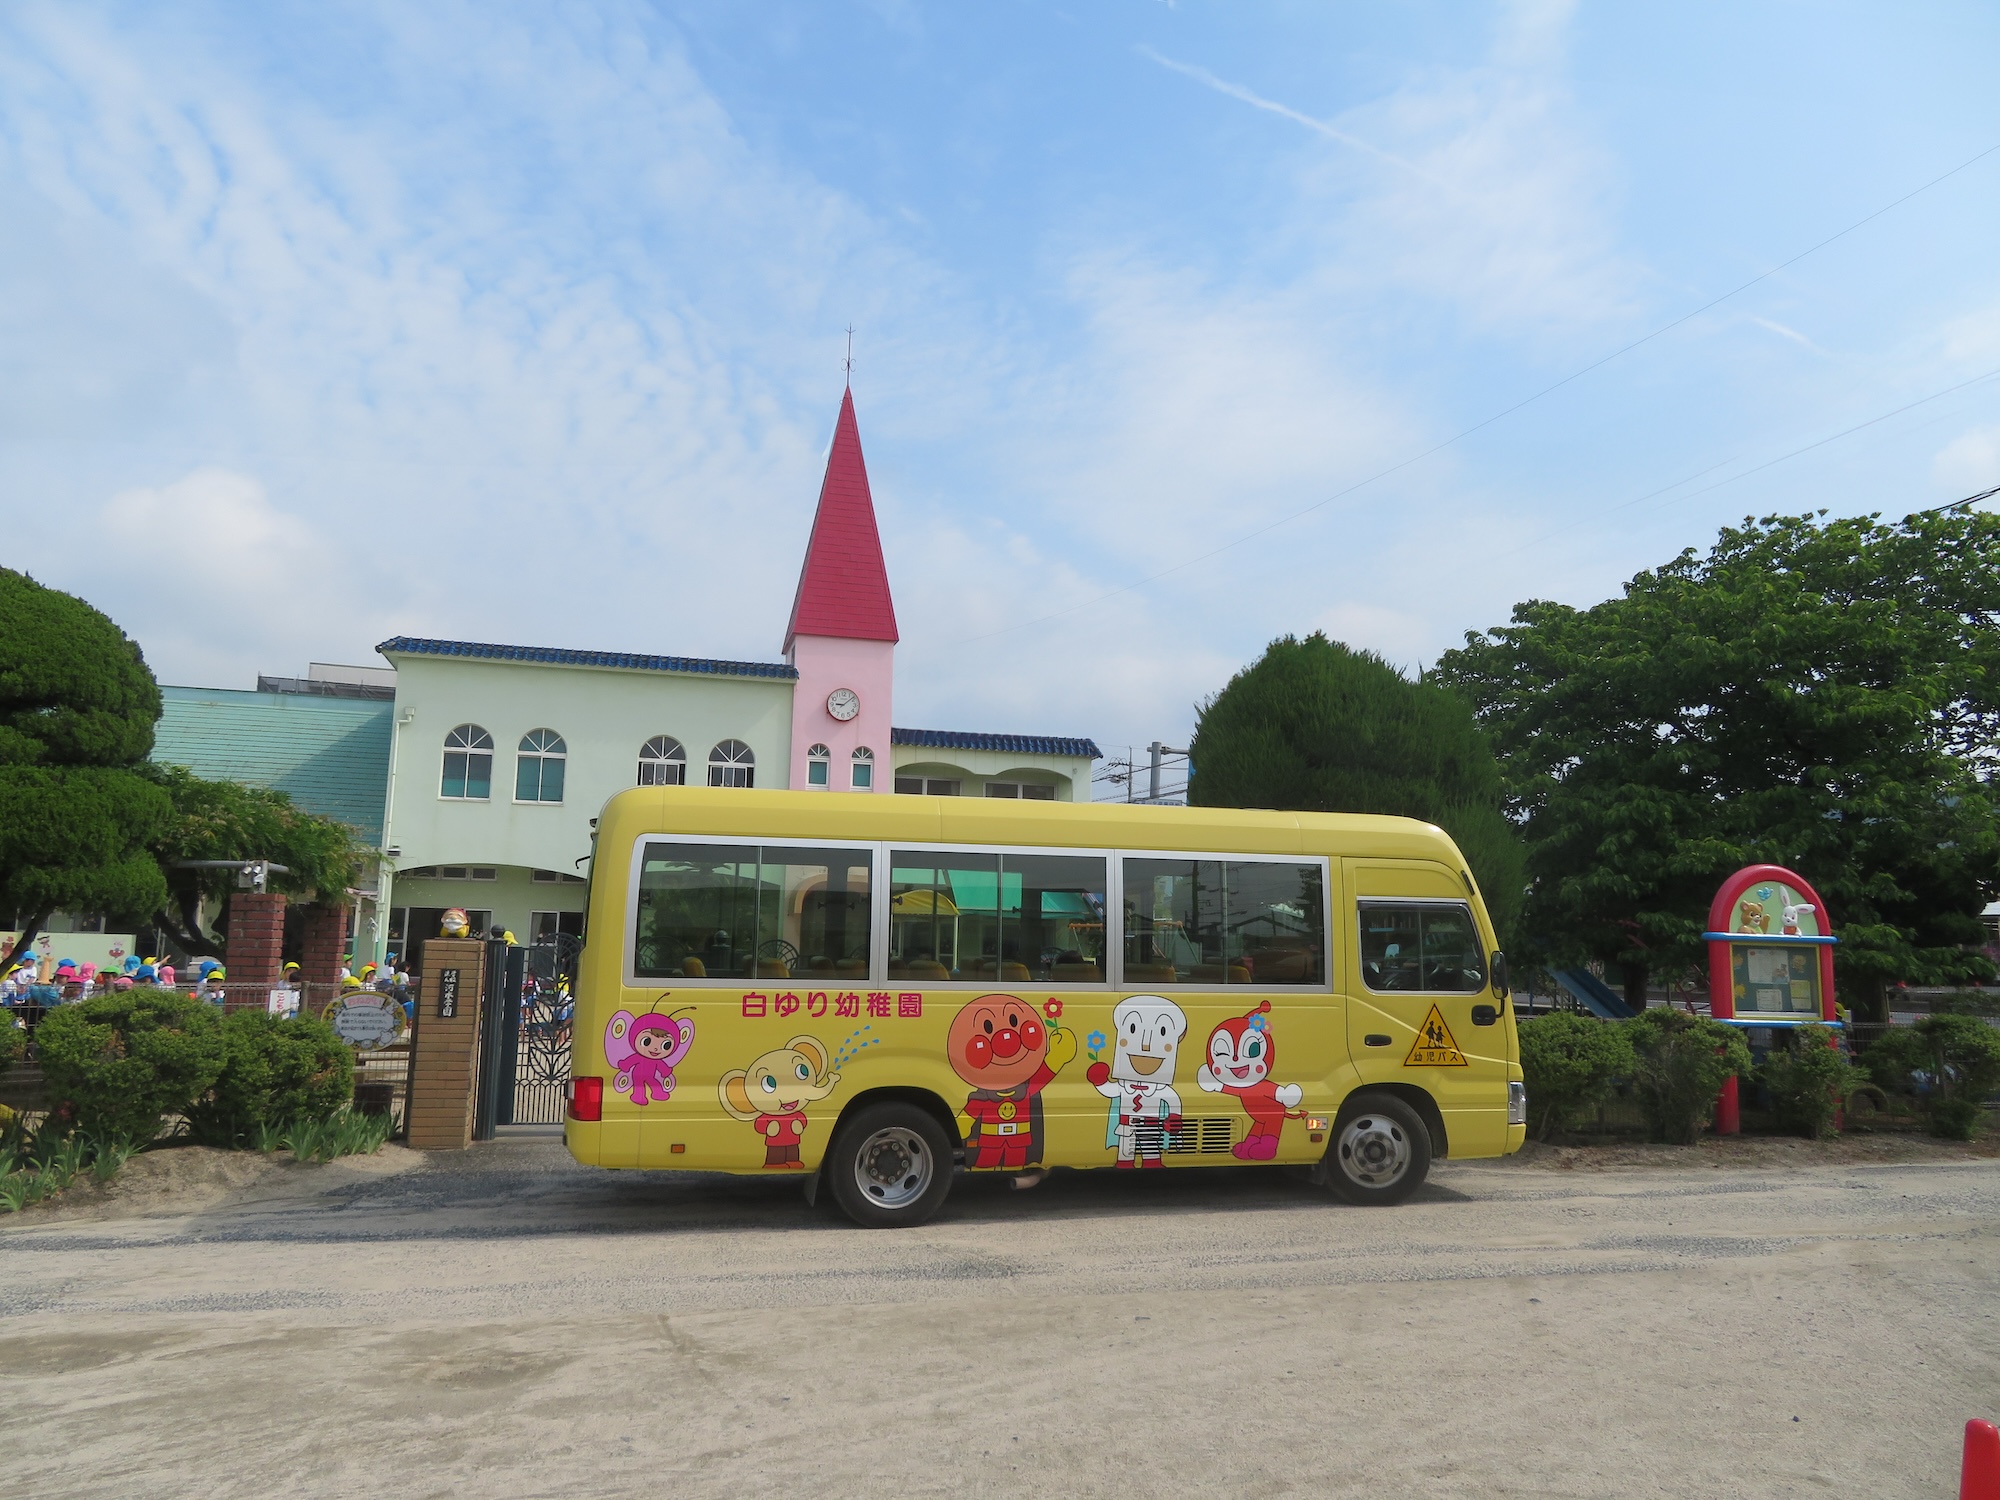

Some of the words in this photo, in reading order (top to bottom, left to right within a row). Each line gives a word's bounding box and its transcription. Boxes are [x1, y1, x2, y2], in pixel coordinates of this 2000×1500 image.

[742, 991, 922, 1018] 白ゆり幼稚園
[1413, 1051, 1458, 1061] 幼児バス
